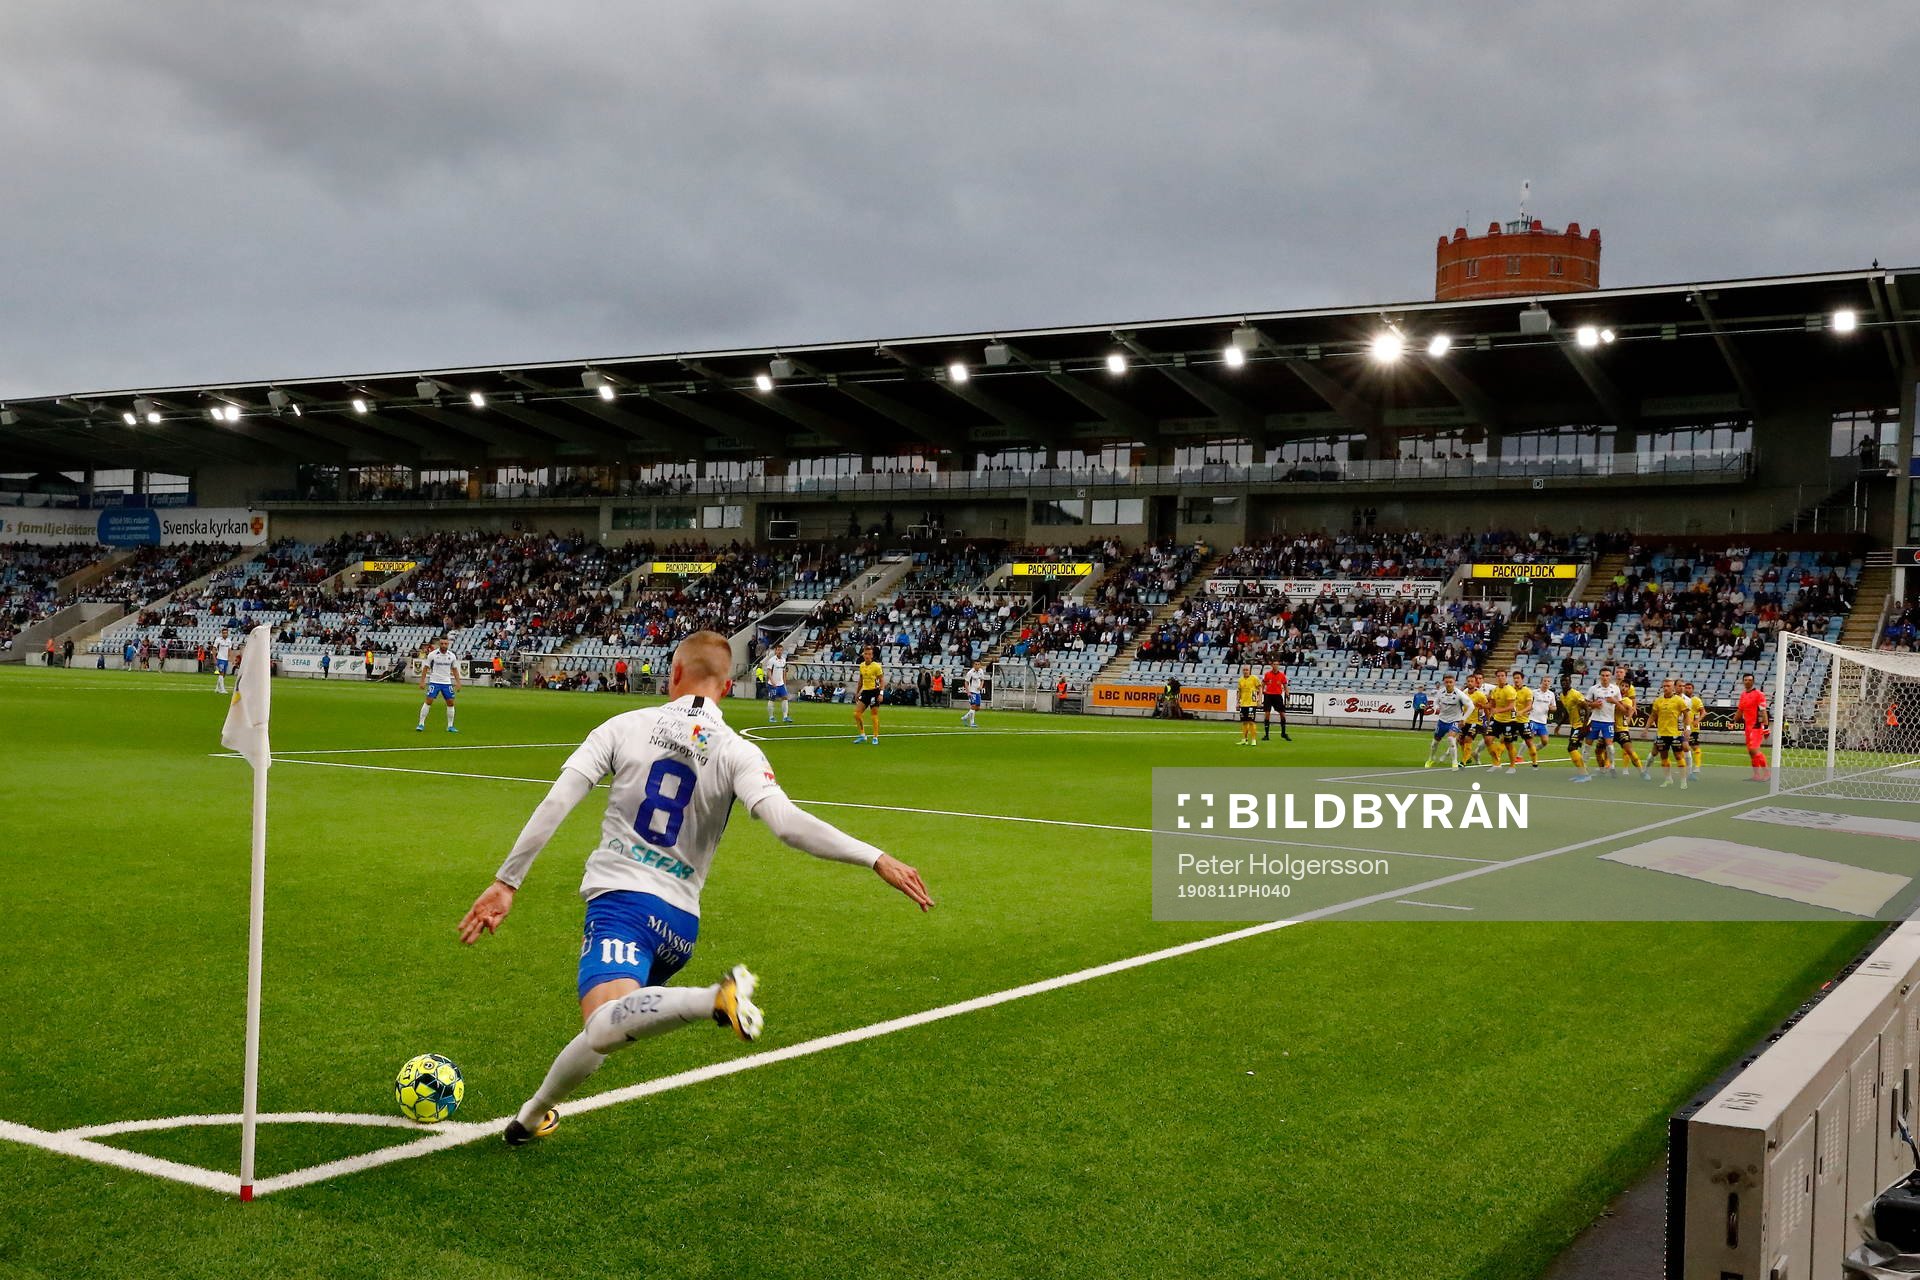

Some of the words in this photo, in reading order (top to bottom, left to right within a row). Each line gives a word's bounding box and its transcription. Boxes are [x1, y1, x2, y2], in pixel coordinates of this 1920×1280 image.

[163, 519, 208, 535] Svenska
[209, 518, 249, 537] kyrkan
[665, 563, 703, 573] PACKOPLOCK
[1027, 564, 1077, 575] PACKOPLOCK
[1492, 565, 1556, 577] PACKOPLOCK
[1098, 690, 1120, 700] LBC
[1124, 691, 1201, 704] NORRING
[1204, 694, 1221, 704] AB
[1725, 720, 1745, 730] Bgg
[649, 735, 709, 767] Norrköping
[633, 757, 698, 848] 8
[629, 843, 695, 881] SEFAB
